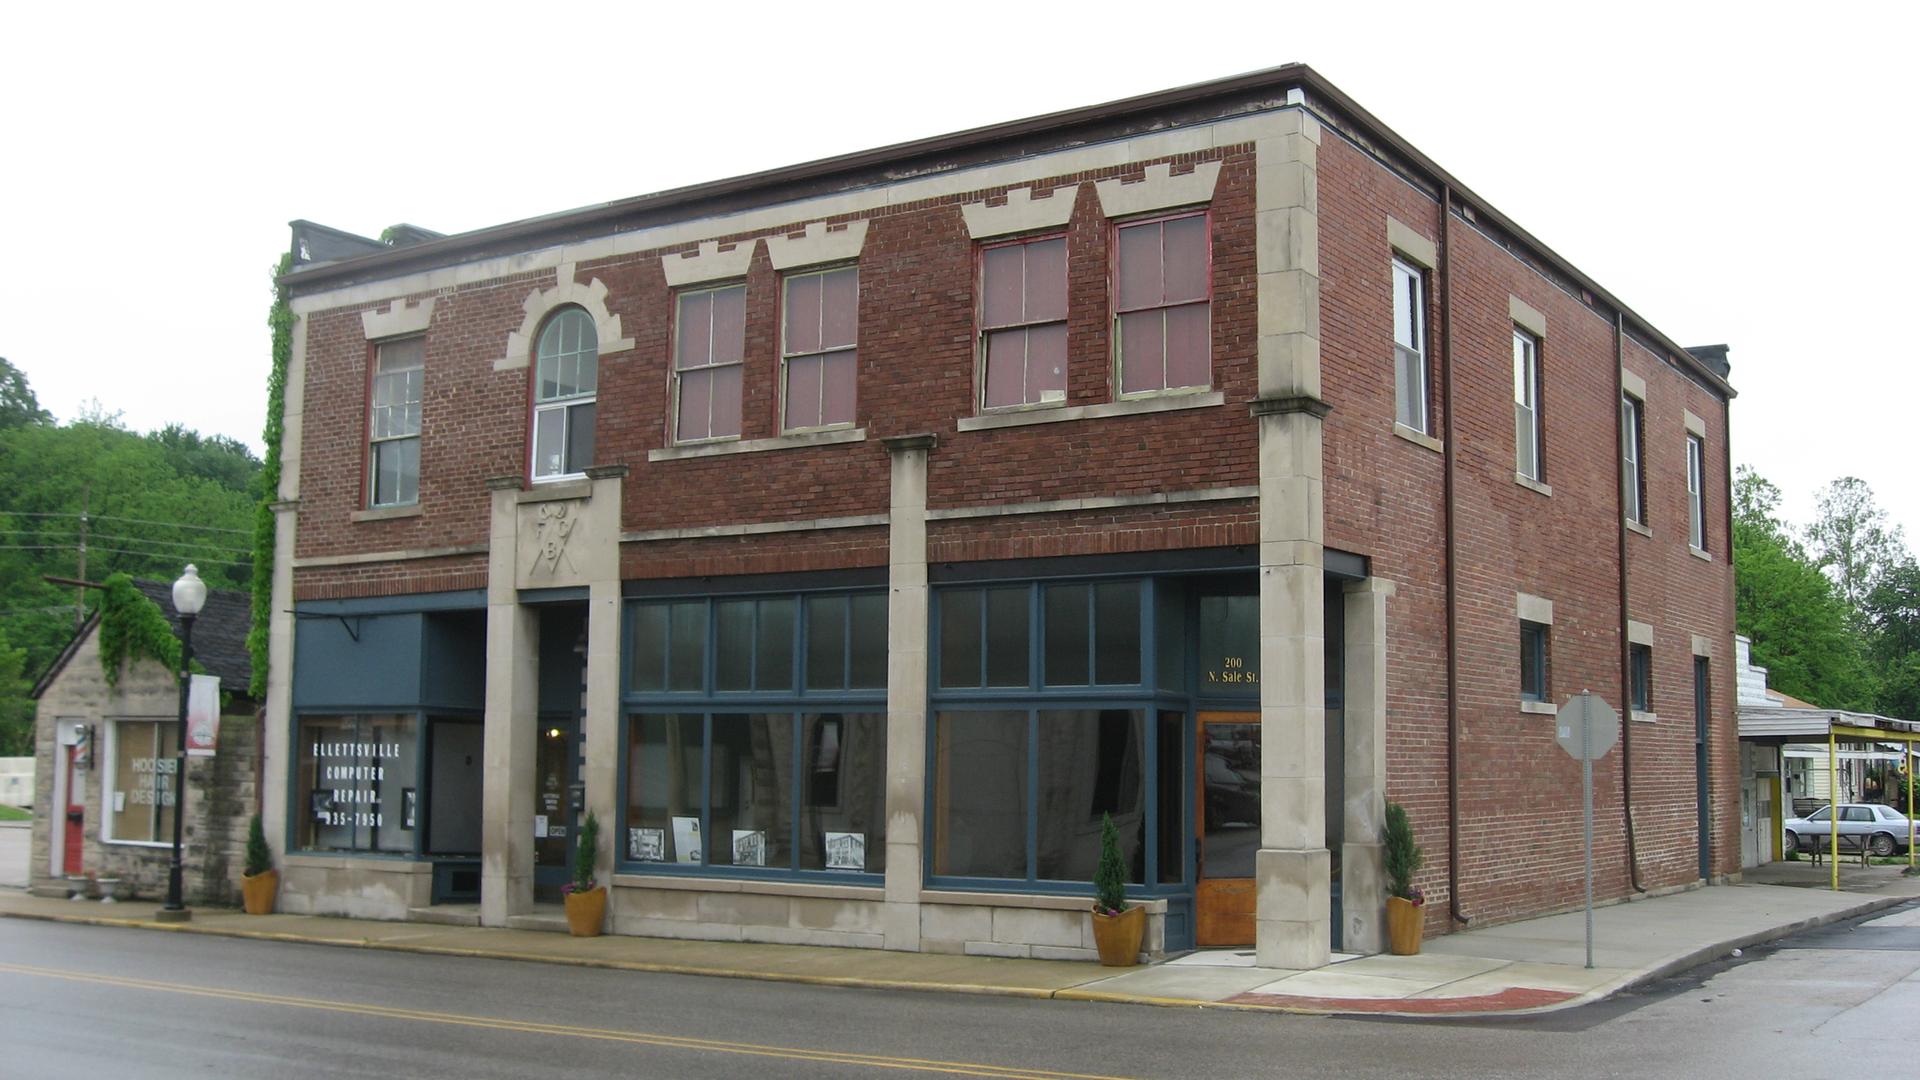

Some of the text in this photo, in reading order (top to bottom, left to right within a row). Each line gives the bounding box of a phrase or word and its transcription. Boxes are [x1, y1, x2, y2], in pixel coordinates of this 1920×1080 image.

[1224, 657, 1242, 668] 200
[1208, 671, 1259, 683] N. Sale St.
[313, 743, 400, 757] ELLETTSVILLE
[326, 766, 384, 780] COMPUTER
[333, 789, 377, 803] REPAIR
